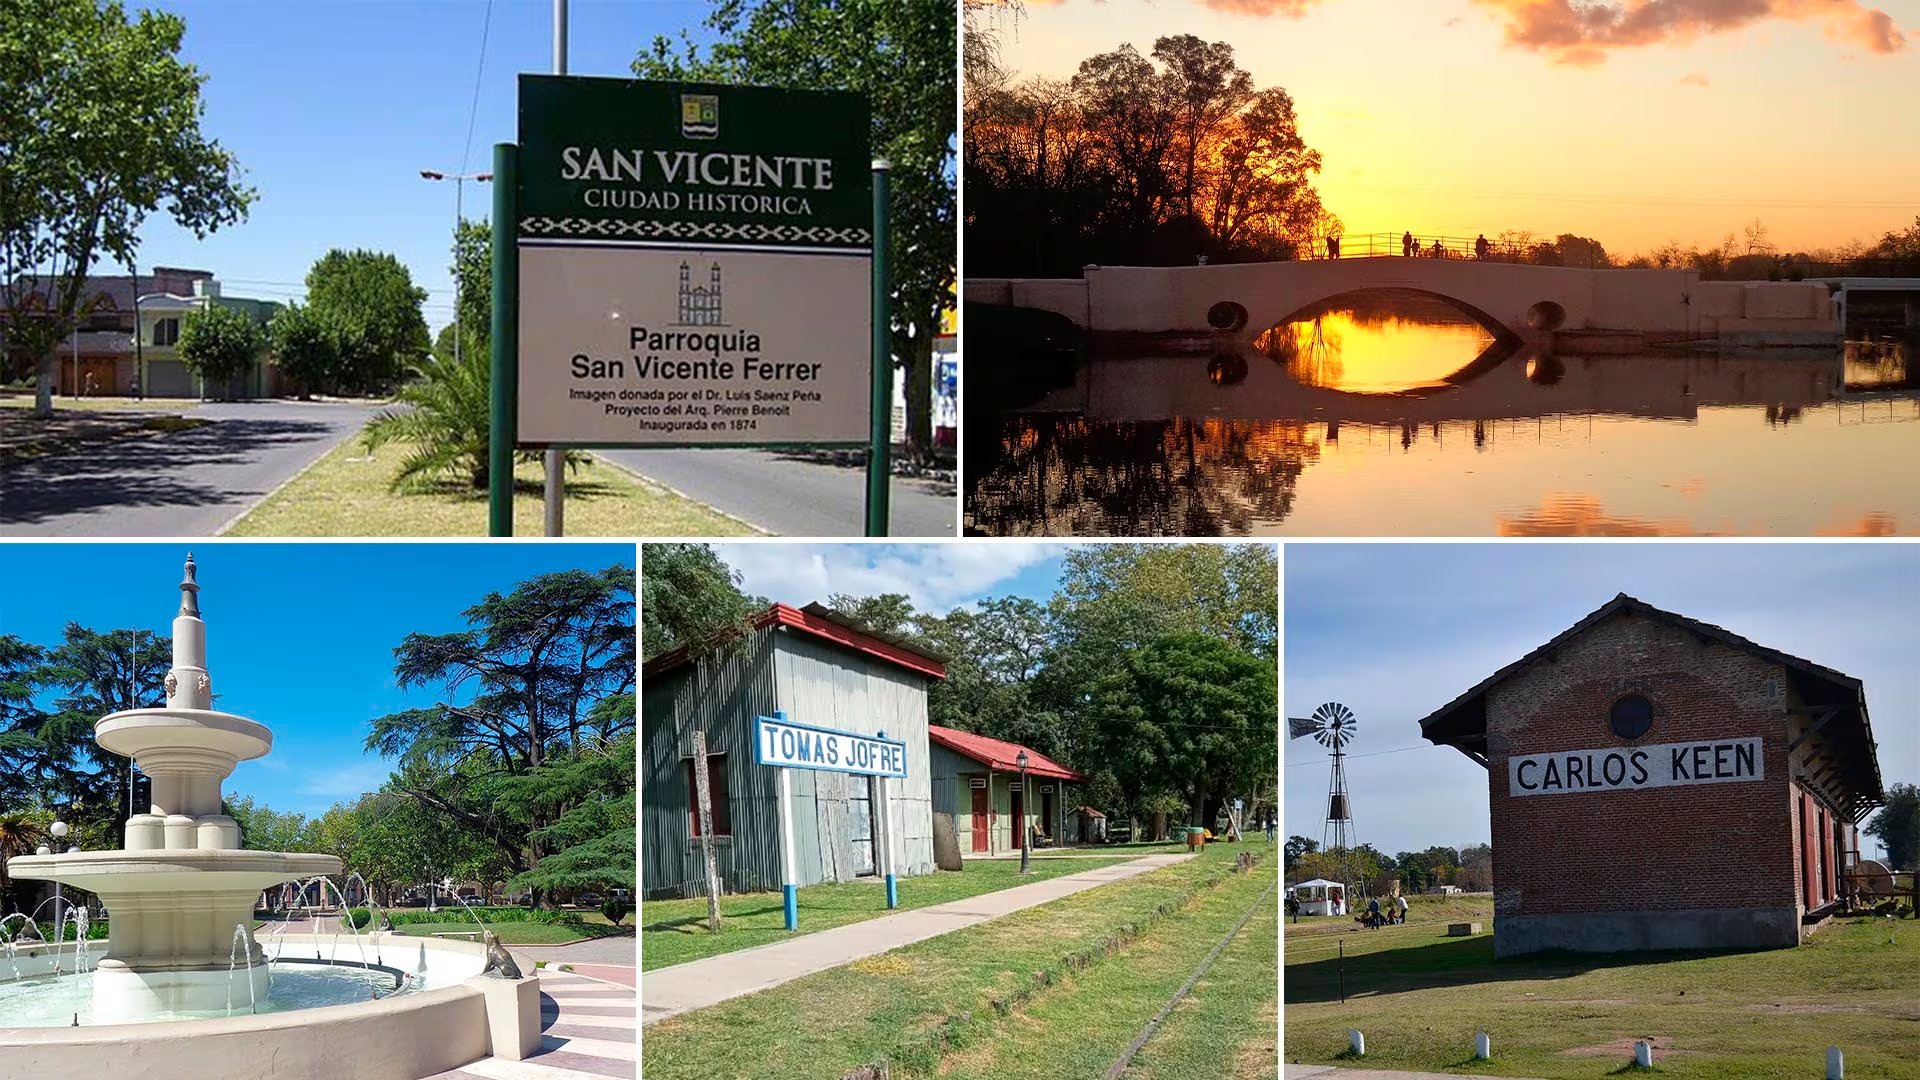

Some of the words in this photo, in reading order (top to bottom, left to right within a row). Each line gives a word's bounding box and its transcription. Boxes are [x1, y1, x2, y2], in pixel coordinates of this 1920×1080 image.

[561, 147, 644, 182] SAN
[653, 150, 833, 190] VICENTE
[584, 188, 680, 211] CIUDAD
[688, 192, 812, 216] HISTORICA
[630, 327, 761, 357] Parroquia
[571, 354, 624, 379] San
[634, 356, 734, 380] Vicente
[743, 357, 822, 381] Ferrer
[569, 388, 616, 402] Imagen
[619, 389, 664, 401] donada
[668, 391, 688, 402] por
[691, 389, 701, 400] el
[706, 389, 722, 401] Dr.
[726, 389, 750, 401] Luis
[793, 390, 821, 402] Peña
[605, 404, 660, 418] Proyecto
[663, 404, 682, 415] del
[685, 404, 710, 417] Arq.
[713, 404, 749, 416] Pierre
[752, 404, 790, 416] Benoit
[640, 419, 707, 432] Inaugurada
[711, 421, 726, 430] en
[730, 419, 756, 430] 1874
[764, 725, 838, 765] TOMAS
[846, 739, 902, 772] JOFRE
[1517, 751, 1649, 790] CARLOS
[1671, 743, 1755, 781] KEEN
